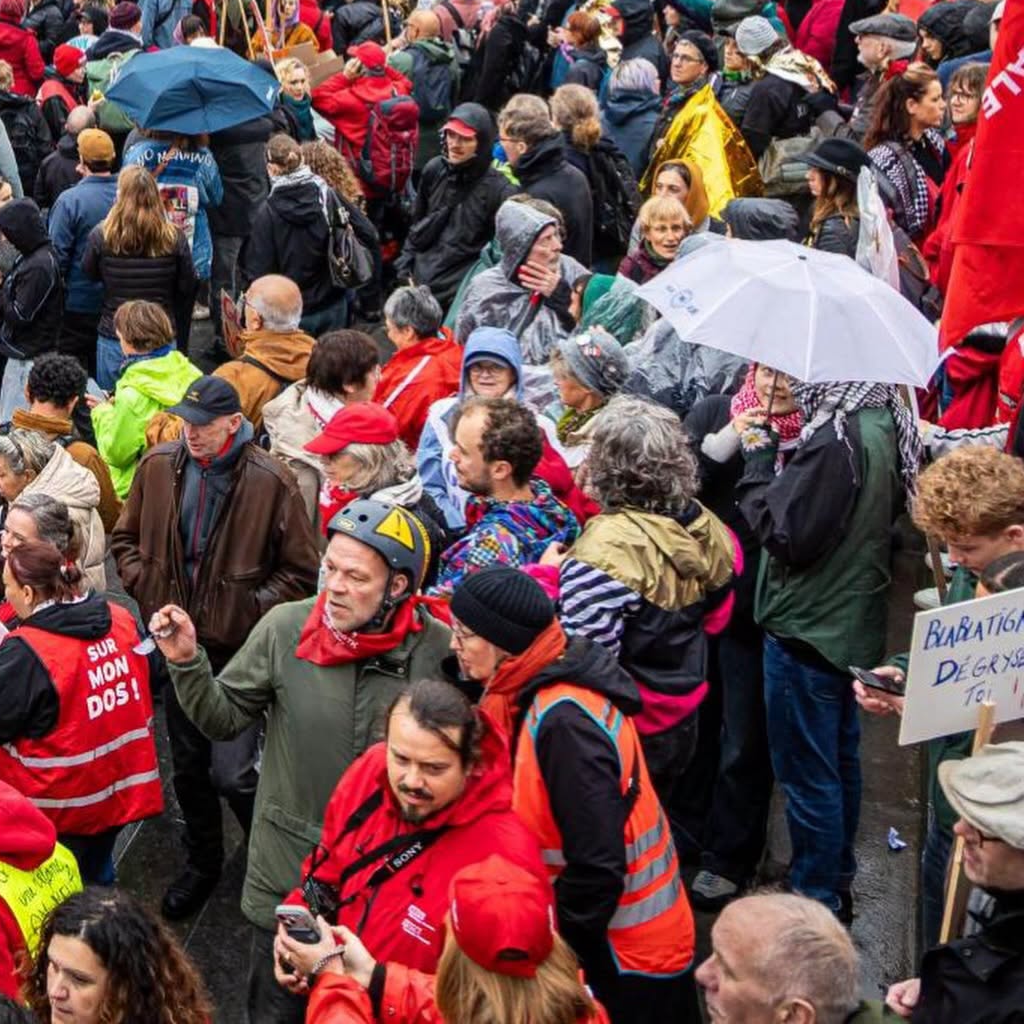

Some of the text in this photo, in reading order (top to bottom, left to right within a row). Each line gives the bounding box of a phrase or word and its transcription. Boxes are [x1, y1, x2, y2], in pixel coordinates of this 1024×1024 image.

[87, 638, 118, 662] SUR
[87, 654, 129, 690] MON
[393, 842, 423, 868] SONY
